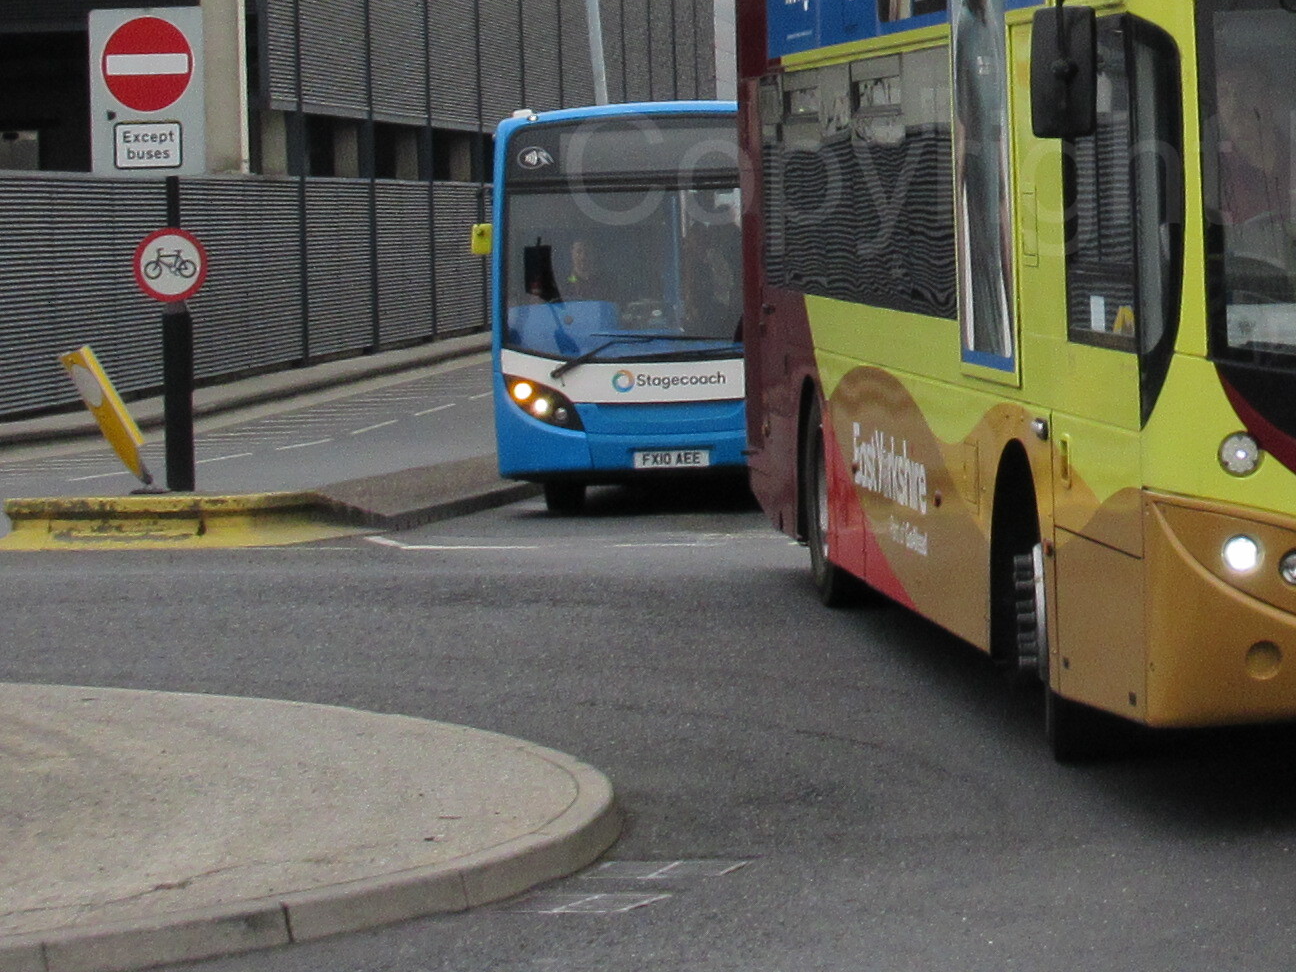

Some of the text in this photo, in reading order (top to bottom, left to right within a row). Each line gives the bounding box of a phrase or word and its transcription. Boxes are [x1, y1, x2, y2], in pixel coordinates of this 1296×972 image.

[122, 130, 174, 144] Except
[126, 147, 171, 160] buses
[635, 370, 727, 391] Stagecoach
[641, 451, 701, 466] FX10 AEE
